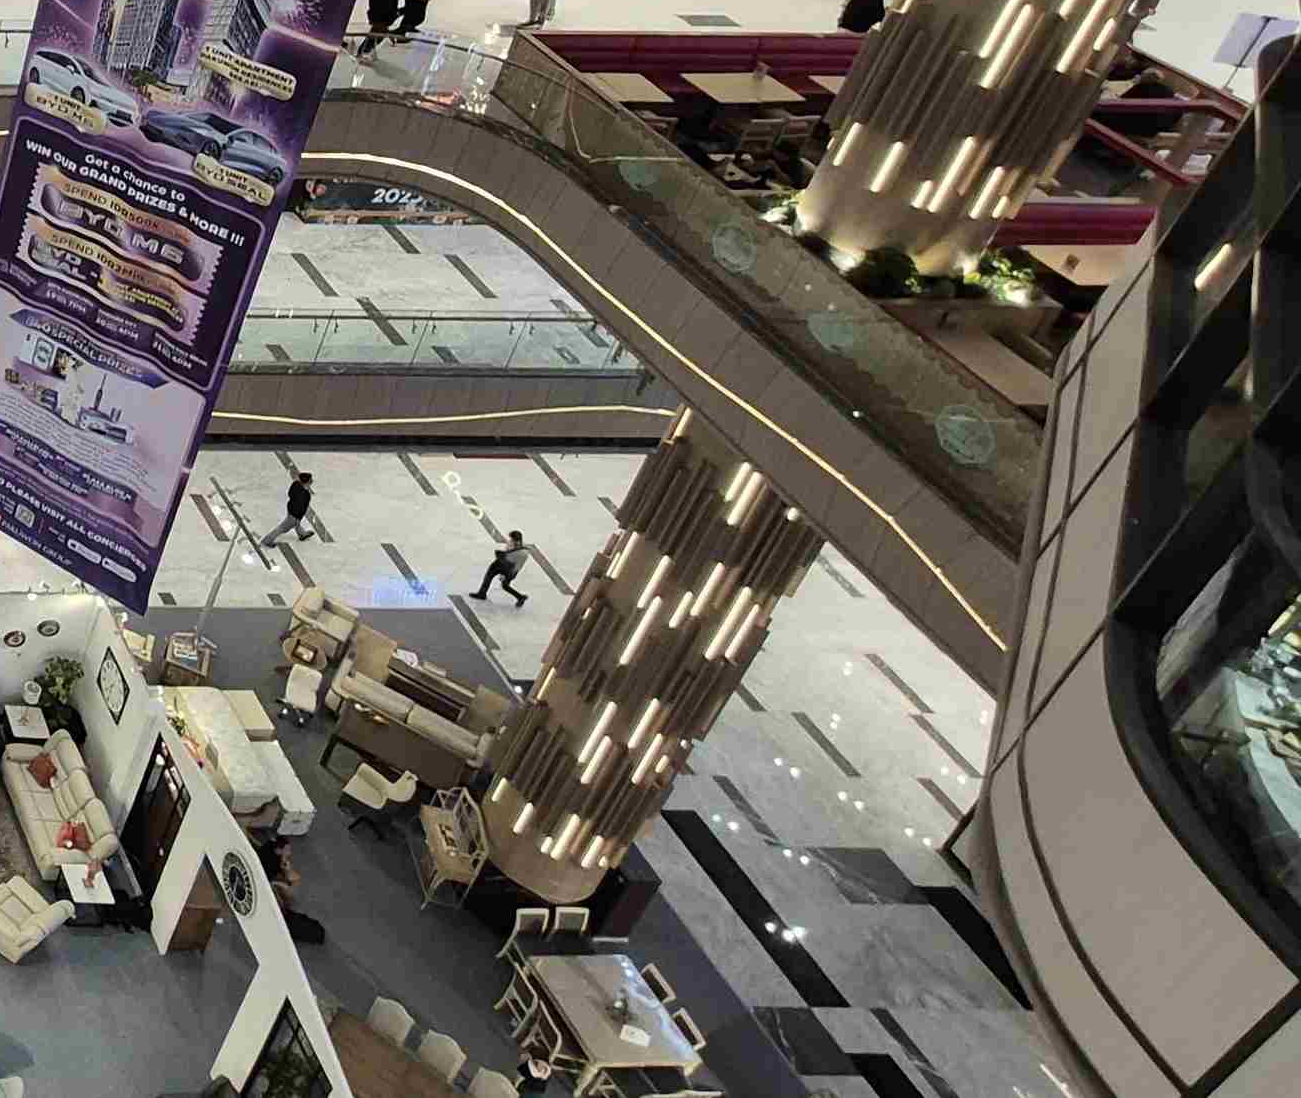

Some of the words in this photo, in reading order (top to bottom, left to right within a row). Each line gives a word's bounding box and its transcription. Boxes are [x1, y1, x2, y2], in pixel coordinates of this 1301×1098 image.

[26, 139, 51, 158] WIN
[53, 152, 77, 172] OUR
[79, 161, 126, 191] GRAND
[127, 186, 177, 214] PRIZES
[189, 211, 229, 240] MORE
[63, 182, 108, 206] SPEND
[85, 154, 109, 170] Get
[123, 167, 167, 196] chance
[171, 189, 186, 202] to
[56, 199, 125, 240] BYD
[52, 234, 94, 256] SPEND
[5, 480, 41, 510] PLEASE
[41, 504, 66, 525] VISIT
[66, 519, 86, 536] ALL
